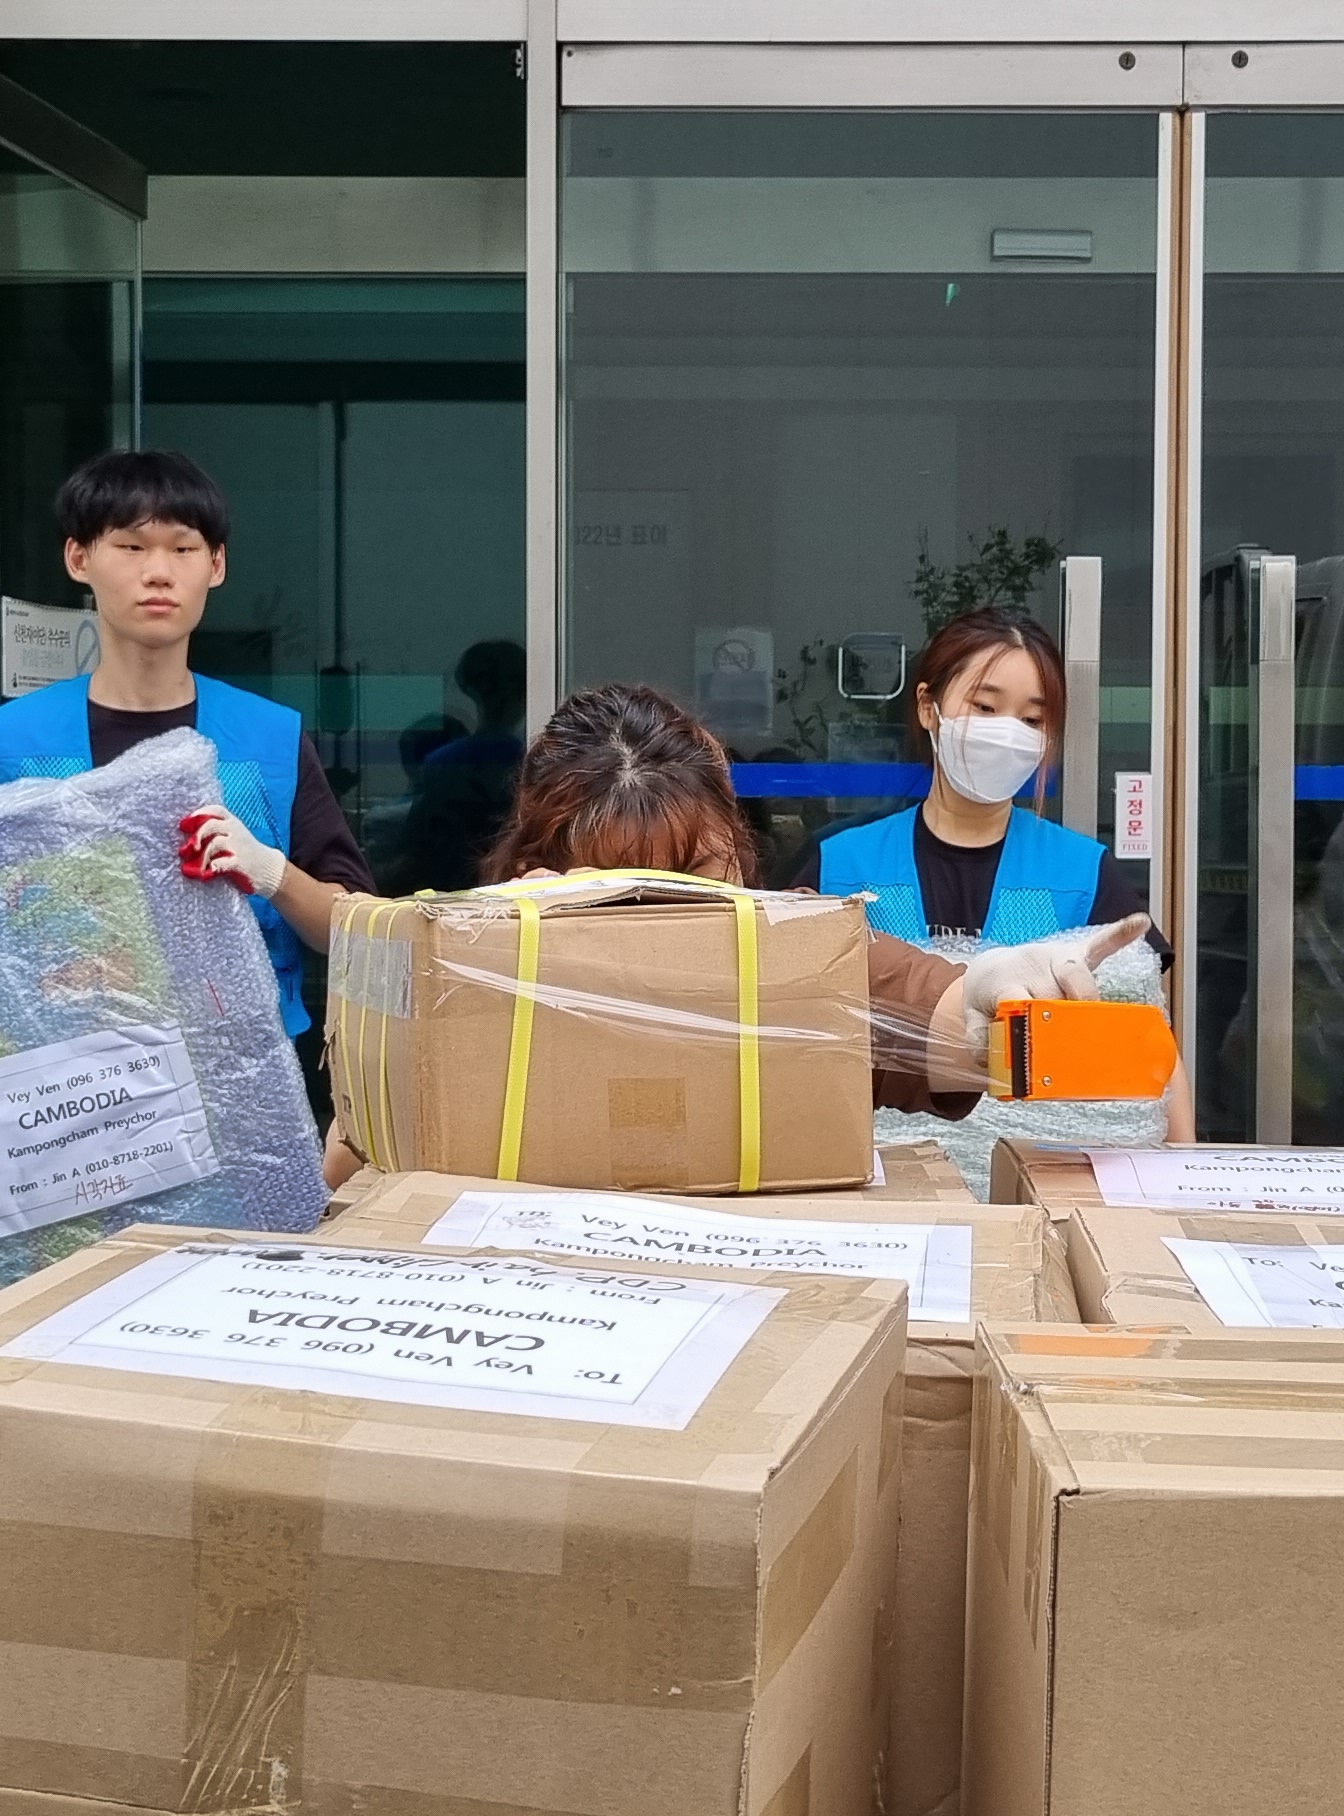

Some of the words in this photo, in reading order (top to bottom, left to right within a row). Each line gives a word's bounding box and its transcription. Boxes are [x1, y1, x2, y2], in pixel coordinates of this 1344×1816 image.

[1127, 779, 1143, 837] 고정문
[1122, 843, 1148, 851] FIXED
[7, 1090, 31, 1105] Vey
[35, 1083, 61, 1097] Ven
[66, 1073, 93, 1090] (096
[99, 1065, 122, 1080] 376
[127, 1055, 161, 1073] 3630)
[18, 1086, 133, 1130] CAMBODIA
[7, 1125, 99, 1159] Kampongcham
[104, 1109, 157, 1132] Preychor
[9, 1181, 39, 1196] From
[51, 1171, 67, 1185] Jin
[72, 1167, 81, 1178] A
[85, 1140, 174, 1176] (010-8718-2201)
[1177, 1184, 1231, 1193] From
[1259, 1186, 1287, 1194] Jin
[1299, 1185, 1314, 1193] A
[581, 1213, 628, 1230] Vey
[642, 1224, 690, 1237] Ven
[706, 1233, 761, 1245] (096
[776, 1238, 822, 1246] 376
[583, 1232, 828, 1257] CAMBODIA
[241, 1261, 465, 1283] (010-8718-2201)
[1243, 1256, 1284, 1268] To:
[482, 1276, 504, 1285] A
[516, 1279, 554, 1290] Jin
[222, 1285, 360, 1306] Preychor
[590, 1288, 661, 1305] From
[377, 1297, 618, 1331] Kampongcham
[119, 1321, 211, 1340] 3630)
[248, 1308, 545, 1351] CAMBODIA
[224, 1333, 287, 1347] 376
[300, 1339, 375, 1355] (096
[393, 1347, 454, 1367] Ven
[474, 1356, 534, 1376] Vey
[573, 1368, 623, 1385] To:
